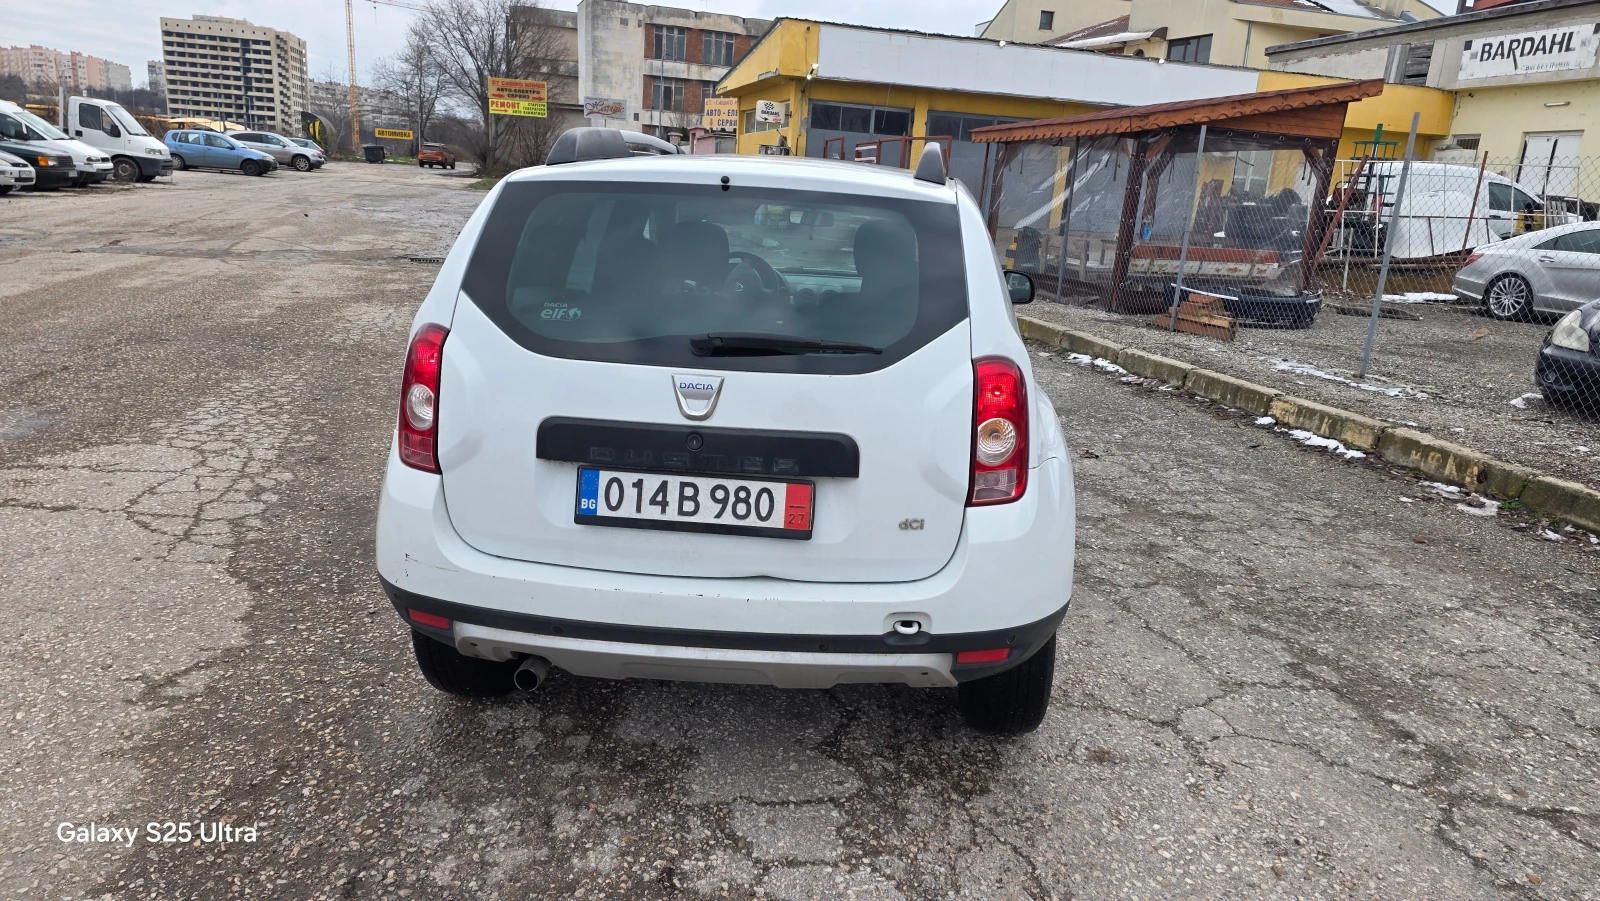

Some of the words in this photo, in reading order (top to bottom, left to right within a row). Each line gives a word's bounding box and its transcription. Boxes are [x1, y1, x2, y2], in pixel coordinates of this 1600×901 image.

[1480, 31, 1575, 71] BARDAHL
[490, 100, 521, 109] РЕМОНТ
[706, 109, 721, 117] АВТО
[378, 129, 411, 138] АВТОМИВКА
[540, 308, 568, 319] elf
[679, 382, 714, 390] DACIA
[590, 446, 799, 475] DUSTER
[581, 498, 596, 509] BG
[788, 513, 805, 525] 27
[898, 517, 925, 531] dCi
